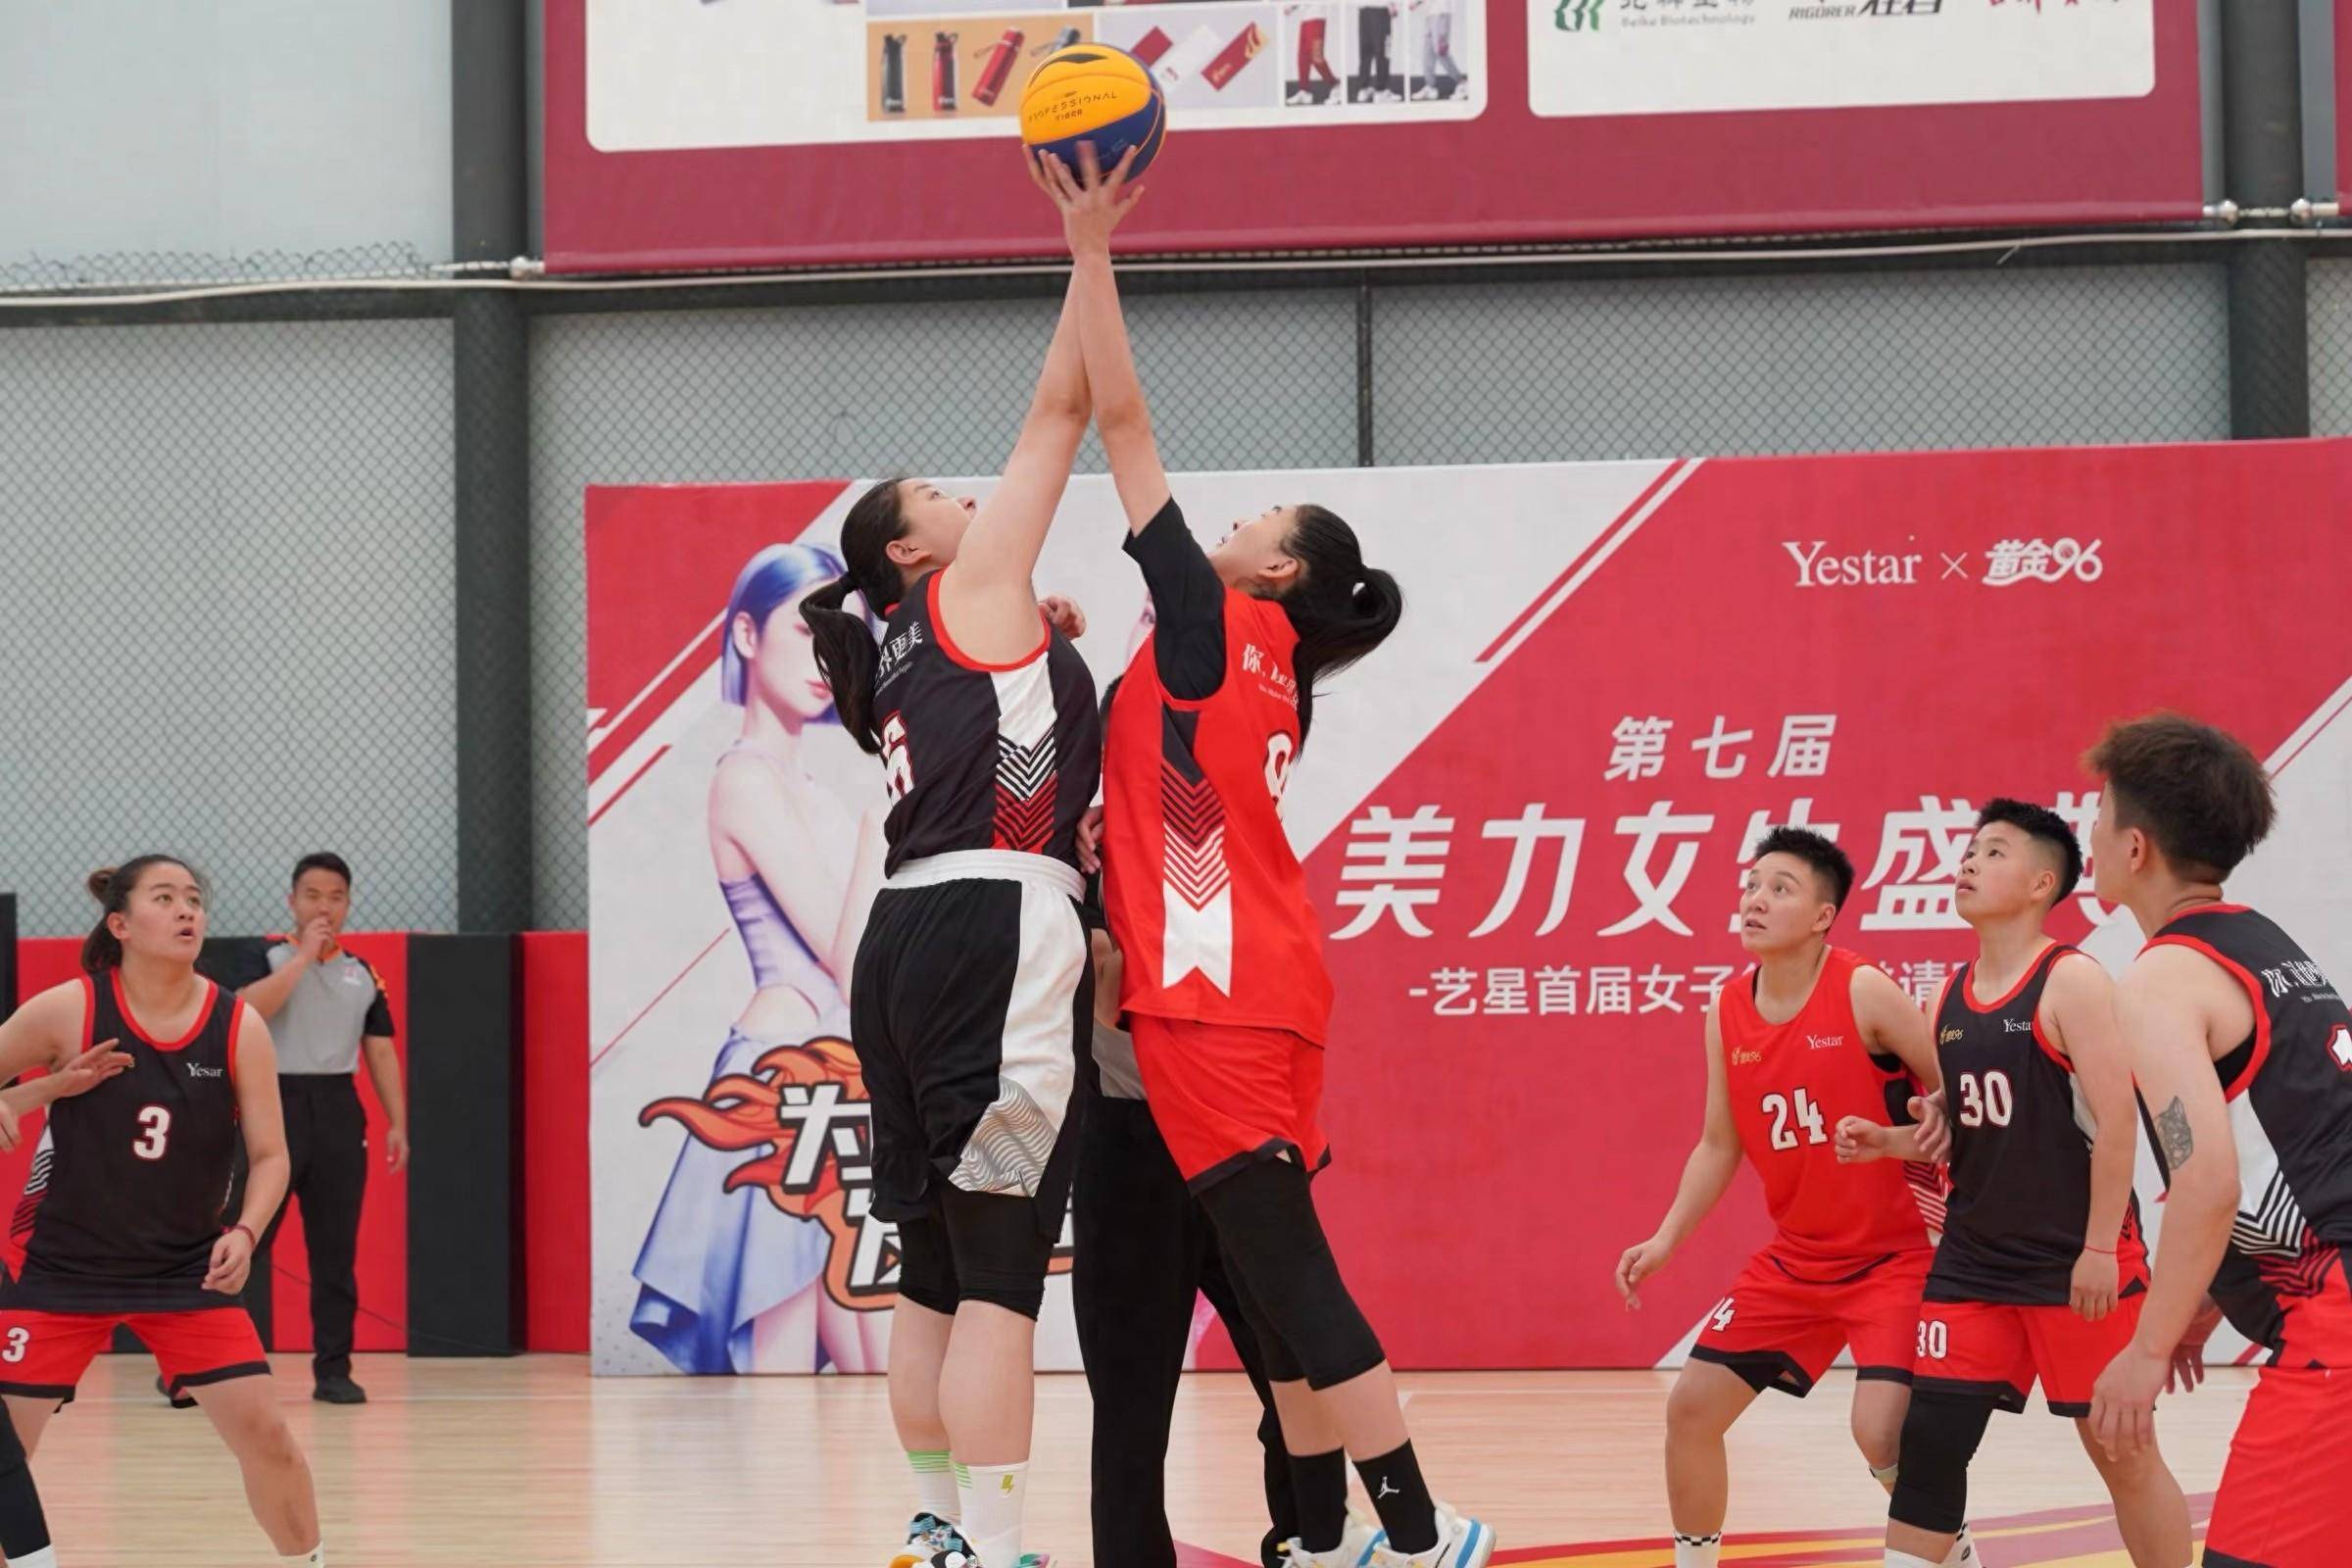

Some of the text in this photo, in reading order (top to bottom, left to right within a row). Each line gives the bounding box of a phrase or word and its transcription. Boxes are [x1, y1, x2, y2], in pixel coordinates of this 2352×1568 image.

[1783, 535, 1923, 586] Yestar
[1603, 714, 1838, 781] 第七届
[1806, 1034, 1843, 1050] Yestar
[2003, 1018, 2033, 1032] Yesta
[1762, 1088, 1829, 1151] 24
[1960, 1070, 2012, 1128] 30
[133, 1105, 172, 1159] 3
[2, 1326, 30, 1363] 3
[1916, 1319, 1948, 1360] 30
